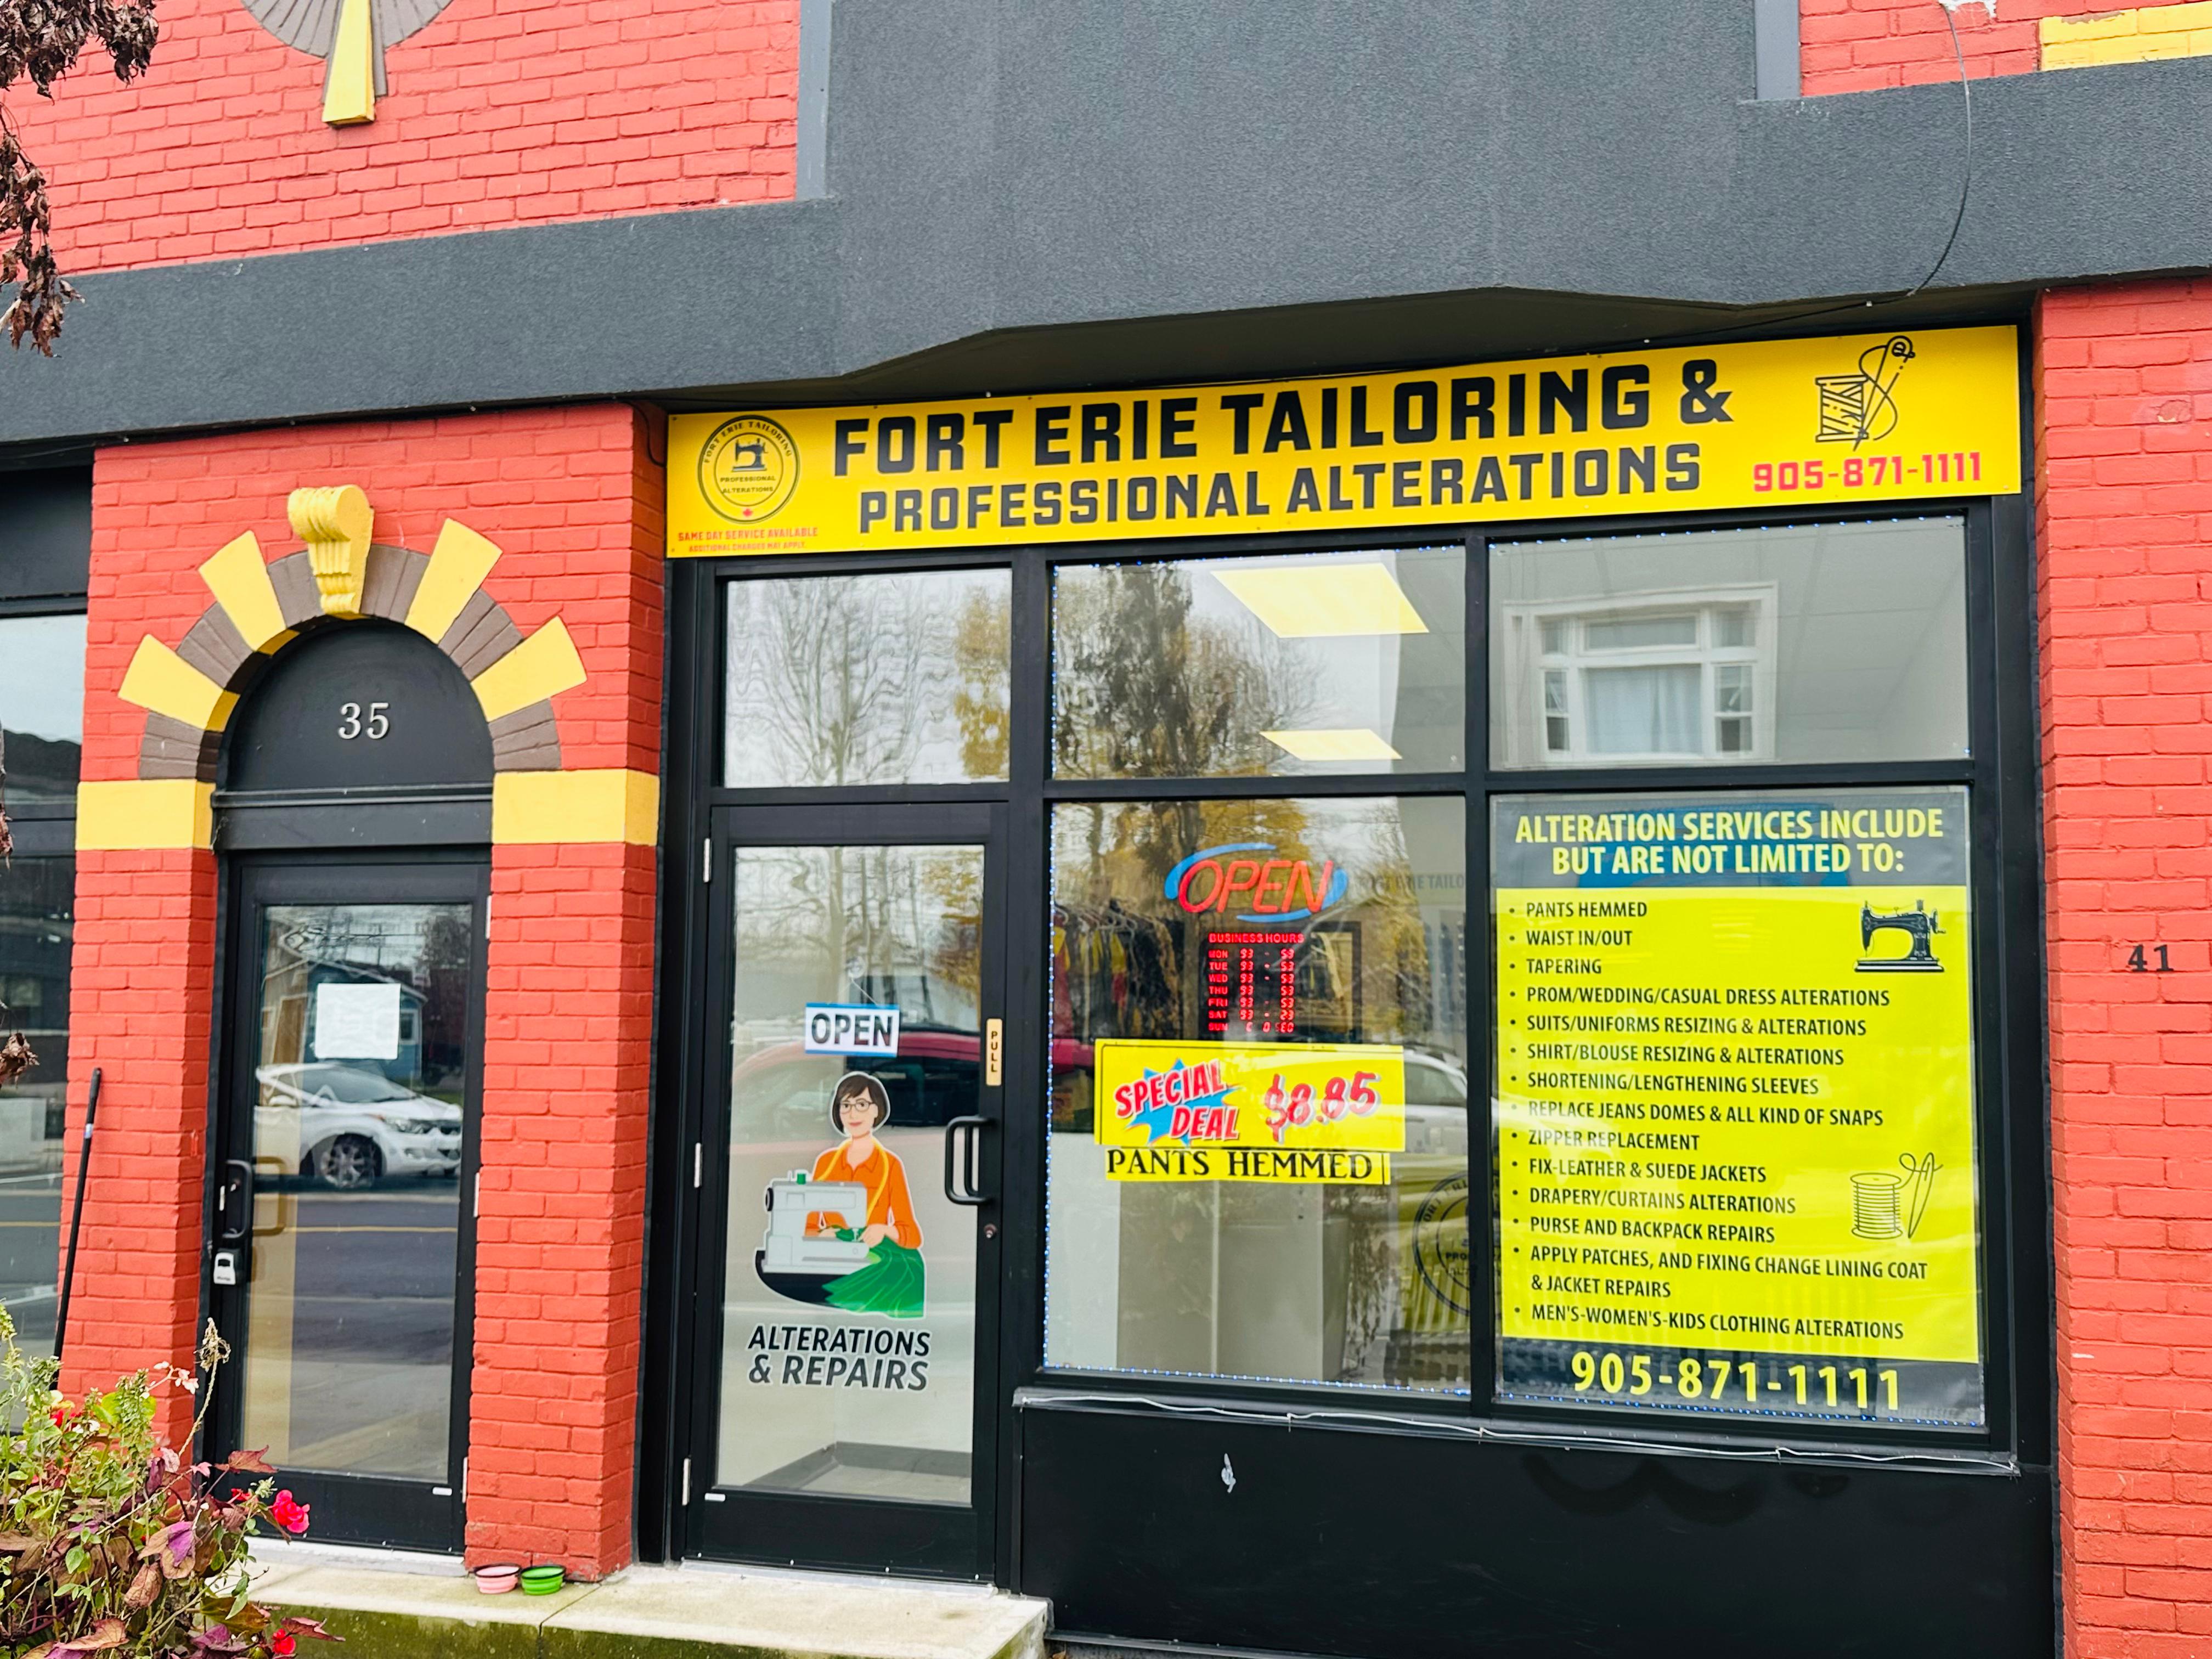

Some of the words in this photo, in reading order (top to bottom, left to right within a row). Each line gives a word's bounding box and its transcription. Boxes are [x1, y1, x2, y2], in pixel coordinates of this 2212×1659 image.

[834, 408, 1013, 476] FORT
[1035, 396, 1198, 466] ERIE
[1220, 363, 1650, 454] TAILORING
[1680, 359, 1734, 424] &
[704, 438, 720, 463] FORT
[721, 423, 743, 437] ERIE
[748, 421, 792, 456] TAILORING
[1753, 452, 1982, 493] 905-871-1111
[860, 471, 1271, 534] PROFESSIONAL
[1286, 443, 1701, 514] ALTERATIONS
[679, 532, 703, 541] SAME
[706, 532, 723, 540] DAY
[725, 529, 764, 539] SERVICE
[768, 528, 817, 538] AVAILABLE
[337, 702, 390, 740] 35
[1516, 814, 1675, 844] ALTERATION
[1685, 811, 1813, 840] SERVICES
[1822, 809, 1943, 838] INCLUDE
[1553, 847, 1607, 874] BUT
[1612, 846, 1663, 874] ARE
[1673, 845, 1728, 873] NOT
[1736, 844, 1851, 873] LIMITED
[1859, 844, 1904, 871] TO:
[1178, 860, 1333, 913] OPEN
[1526, 902, 1574, 917] PANTS
[1579, 901, 1647, 917] HEMMED
[1209, 933, 1263, 943] BUSINESS
[1265, 933, 1305, 943] HOURS
[1526, 930, 1575, 946] WAIST
[1578, 930, 1632, 946] IN/OUT
[1209, 949, 1228, 958] MON
[1209, 961, 1228, 970] TUE
[1526, 958, 1601, 974] TAPERING
[2128, 944, 2174, 972] 41
[1209, 973, 1228, 983] WED
[1209, 986, 1228, 995] THU
[1209, 998, 1228, 1007] FRI
[1527, 988, 1722, 1005] PROM/WEDDING/CASUAL
[1726, 989, 1777, 1005] DRESS
[1781, 990, 1890, 1006] ALTERATIONS
[1209, 1011, 1228, 1019] SAT
[1209, 1022, 1228, 1031] SUN
[1527, 1015, 1660, 1033] SUITS/UNIFORMS
[1664, 1018, 1737, 1034] RESIZING
[1741, 1019, 1754, 1034] &
[1758, 1019, 1866, 1036] ALTERATIONS
[811, 1013, 893, 1047] OPEN
[1527, 1044, 1639, 1061] SHIRT/BLOUSE
[1643, 1047, 1716, 1063] RESIZING
[1720, 1048, 1732, 1063] &
[1736, 1048, 1844, 1066] ALTERATIONS
[1114, 1059, 1227, 1118] SPECIAL
[1528, 1072, 1747, 1093] SHORTENING/LENGTHENING
[1752, 1077, 1819, 1094] SLEEVES
[1265, 1070, 1380, 1144] $8.85
[1529, 1101, 1594, 1118] REPLACE
[1598, 1103, 1646, 1120] JEANS
[1650, 1105, 1706, 1121] DOMES
[1709, 1107, 1722, 1122] &
[1726, 1108, 1755, 1123] ALL
[1759, 1108, 1800, 1124] KIND
[1804, 1109, 1826, 1125] OF
[1829, 1110, 1883, 1126] SNAPS
[1169, 1106, 1239, 1141] DEAL
[1529, 1130, 1583, 1147] ZIPPER
[1587, 1132, 1700, 1150] REPLACEMENT
[1107, 1149, 1209, 1176] PANTS
[1229, 1153, 1373, 1178] HEMMED
[1529, 1158, 1626, 1177] FIX-LEATHER
[1630, 1163, 1642, 1178] &
[1646, 1163, 1696, 1180] SUEDE
[1700, 1166, 1766, 1182] JACKETS
[1530, 1187, 1685, 1210] DRAPERY/CURTAINS
[1689, 1194, 1796, 1214] ALTERATIONS
[1530, 1216, 1580, 1234] PURSE
[1584, 1220, 1617, 1235] AND
[1622, 1221, 1703, 1240] BACKPACK
[1707, 1224, 1775, 1243] REPAIRS
[1530, 1245, 1578, 1263] APPLY
[1582, 1248, 1654, 1269] PATCHES,
[1658, 1252, 1692, 1269] AND
[1696, 1253, 1751, 1272] FIXING
[1754, 1256, 1821, 1275] CHANGE
[1826, 1260, 1884, 1277] LINING
[1888, 1262, 1928, 1279] COAT
[1531, 1275, 1543, 1291] &
[1545, 1275, 1601, 1294] JACKET
[1605, 1278, 1671, 1297] REPAIRS
[1531, 1304, 1706, 1330] MEN'S-WOMEN'S-KIDS
[1709, 1314, 1790, 1334] CLOTHING
[1794, 1318, 1904, 1340] ALTERATIONS
[748, 1325, 930, 1356] ALTERATIONS
[749, 1355, 771, 1384] &
[783, 1356, 929, 1391] REPAIRS
[1571, 1352, 1900, 1411] 905-871-1111
